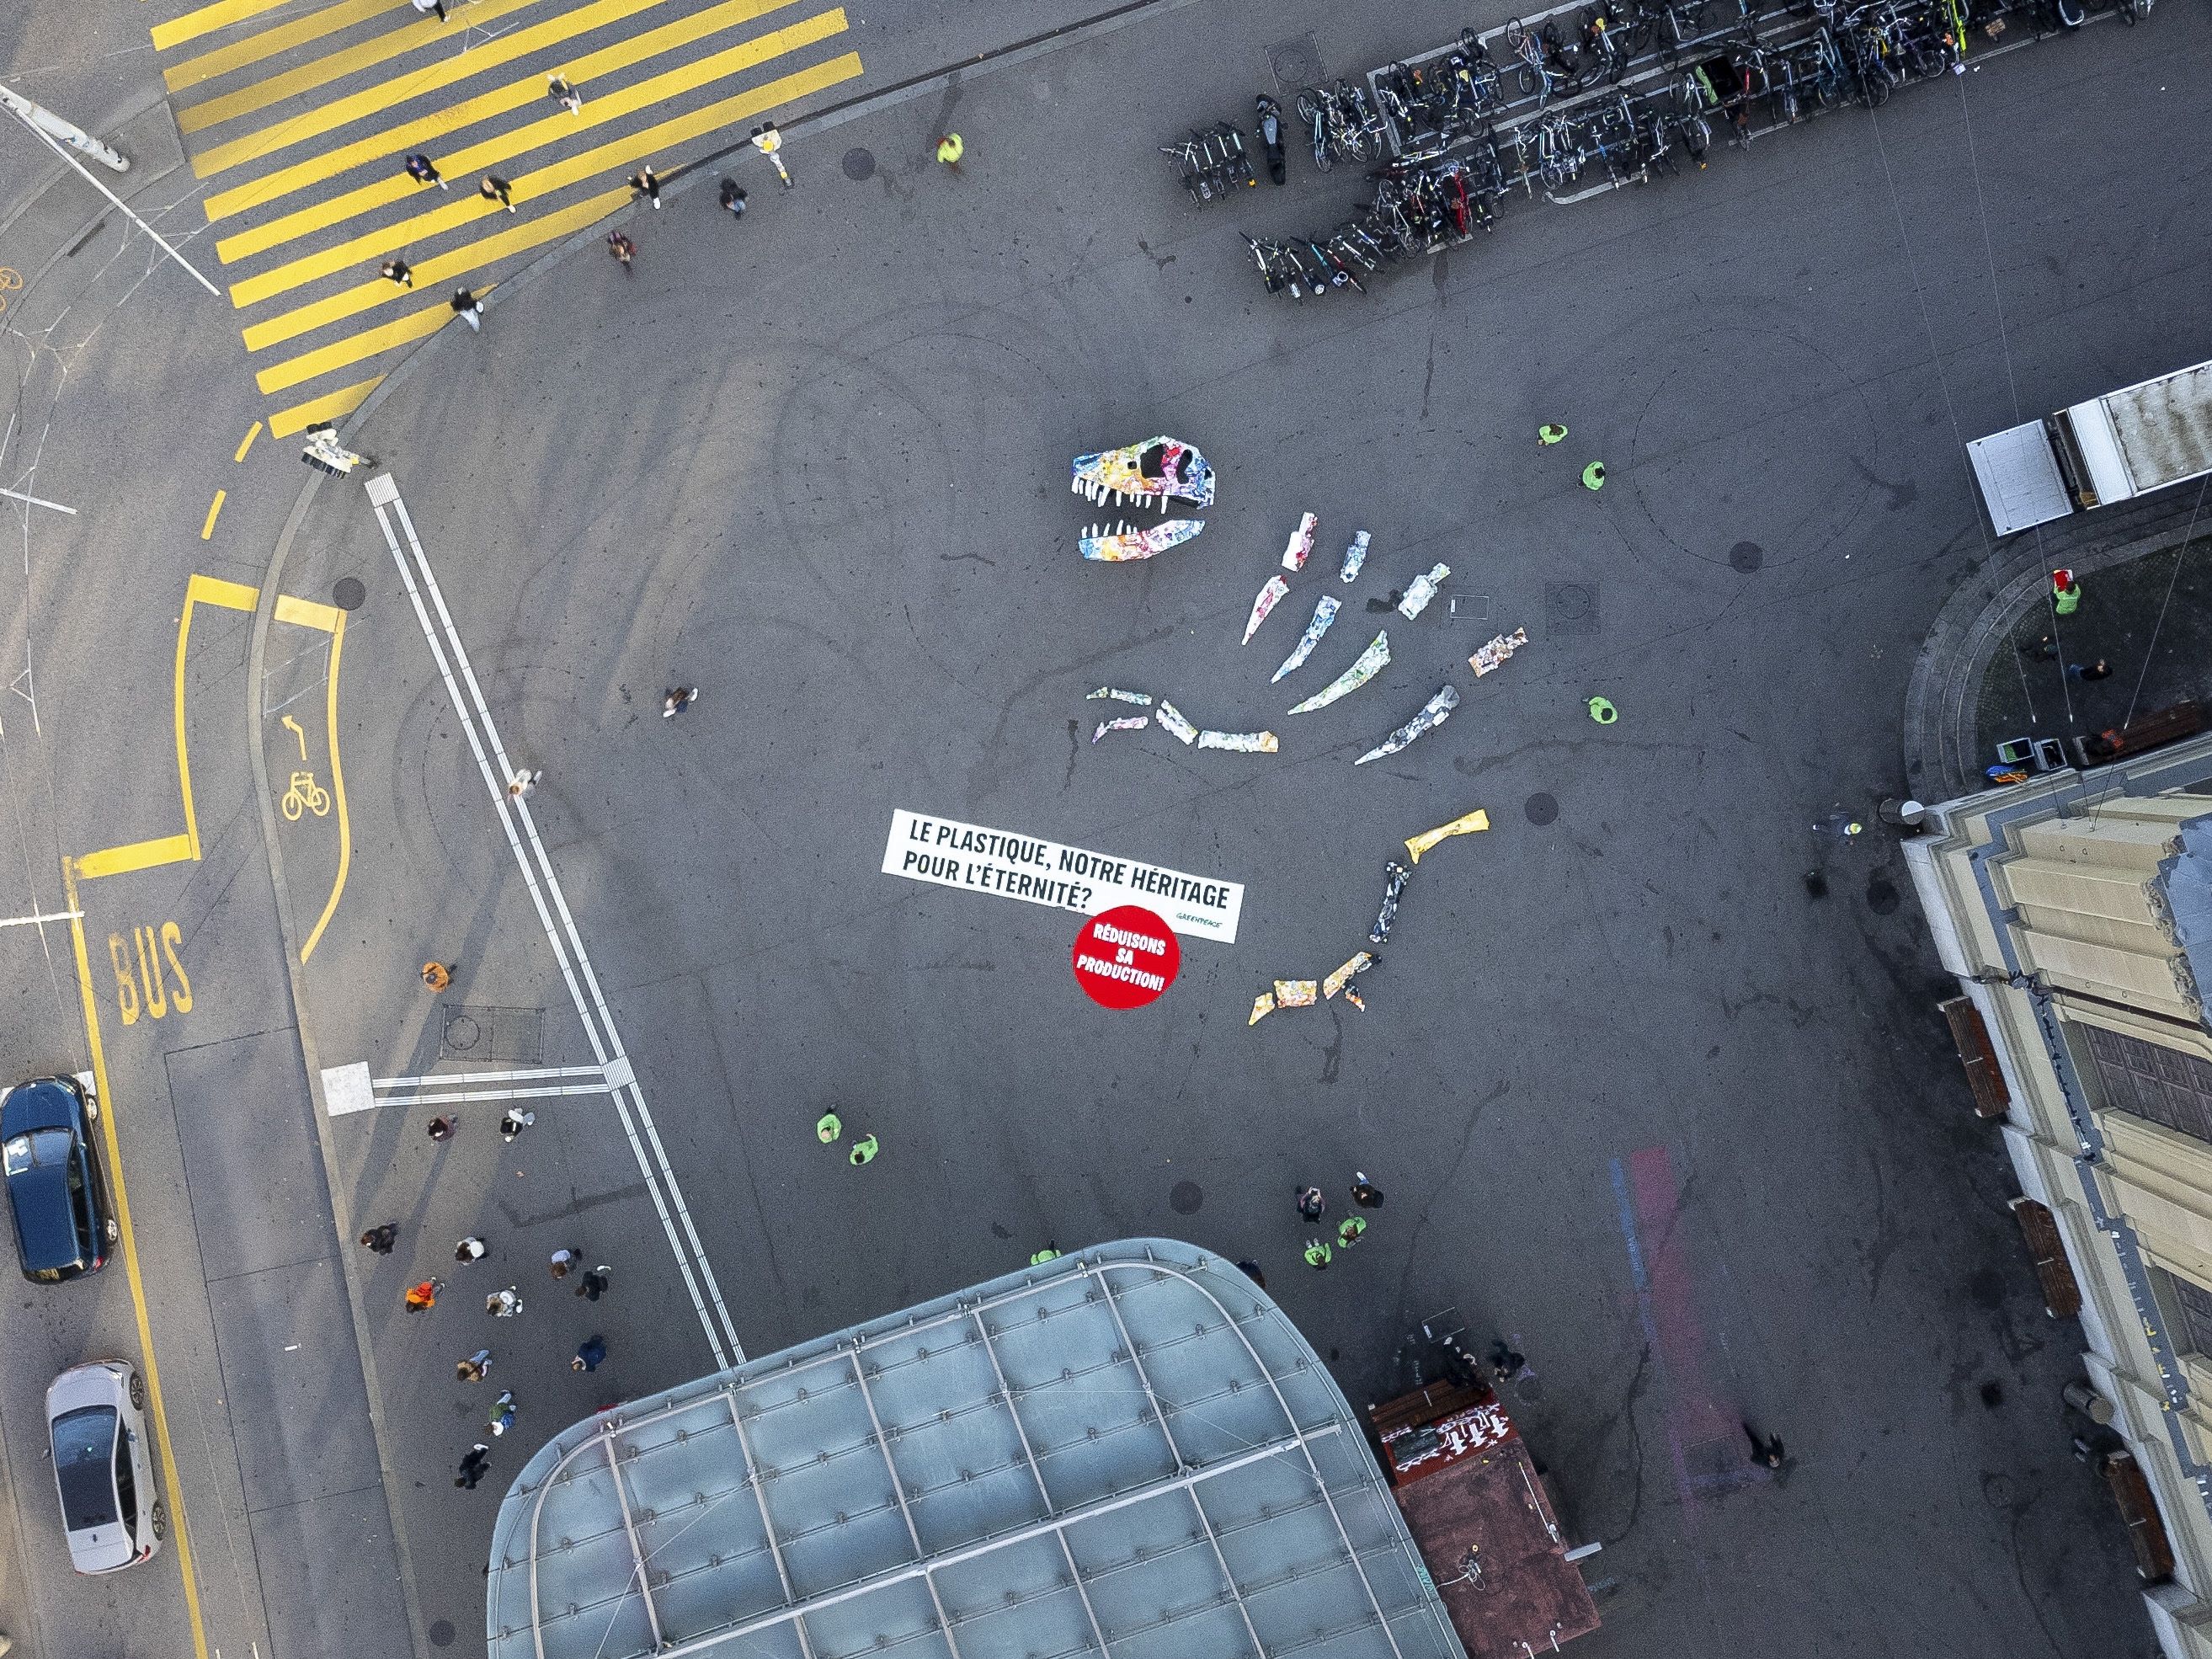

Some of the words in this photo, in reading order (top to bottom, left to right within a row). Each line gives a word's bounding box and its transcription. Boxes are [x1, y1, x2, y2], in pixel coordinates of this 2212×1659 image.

[903, 851, 958, 881] POUR
[909, 819, 932, 843] LE
[936, 826, 1052, 871] PLASTIQUE,
[1059, 850, 1126, 886] NOTRE
[1131, 867, 1229, 910] HÉRITAGE
[1175, 912, 1223, 928] GREENPEACE
[1093, 923, 1166, 957] RÉDUISONS
[109, 921, 193, 1025] BUS
[1077, 954, 1165, 992] PRODUCTION!
[1116, 949, 1133, 967] SA
